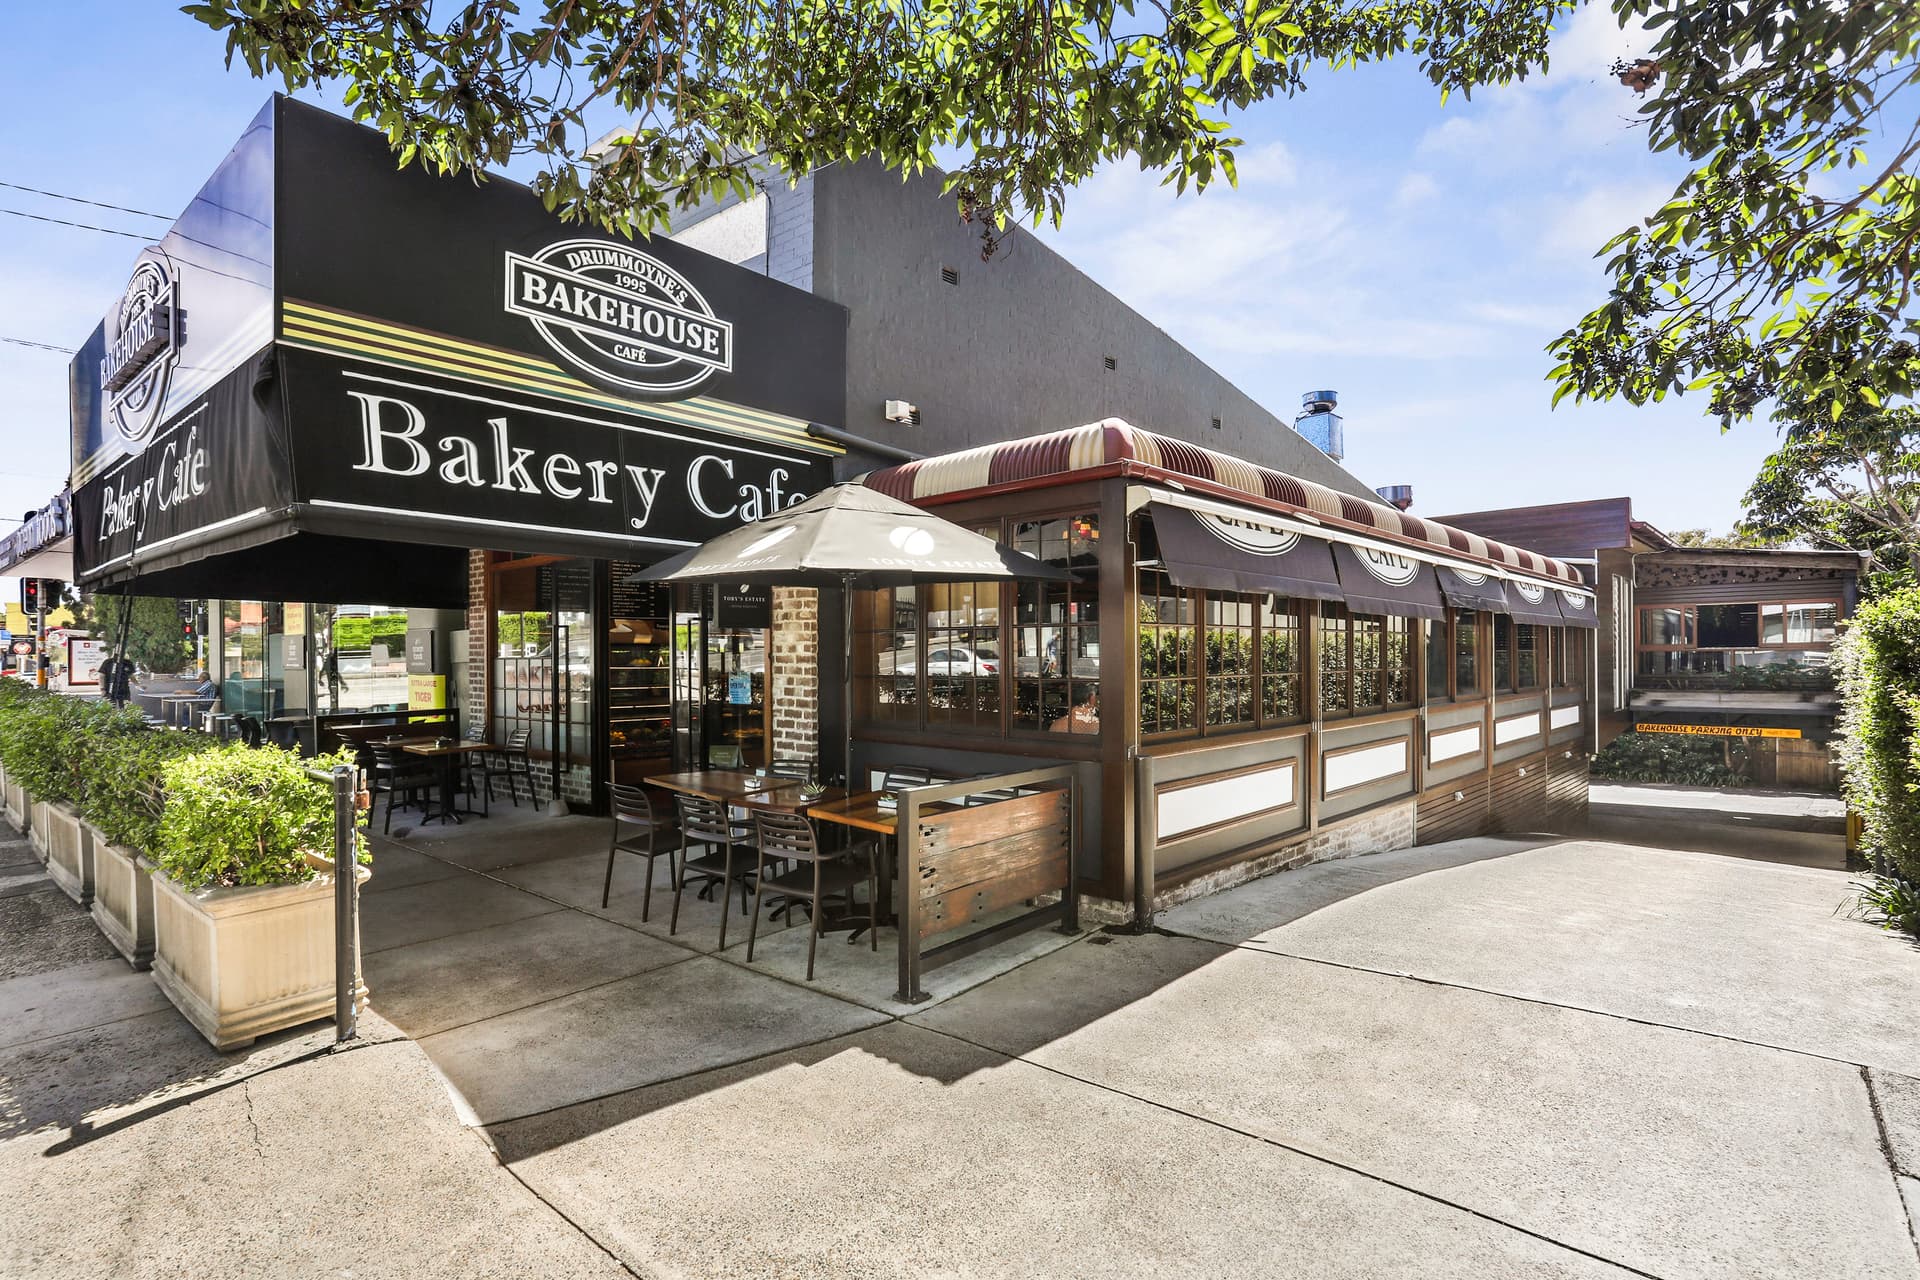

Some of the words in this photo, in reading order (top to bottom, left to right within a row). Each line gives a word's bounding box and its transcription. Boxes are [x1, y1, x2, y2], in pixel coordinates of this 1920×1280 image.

[566, 249, 688, 303] DRUMMOYNE'S
[614, 273, 647, 293] 1995
[522, 271, 719, 355] BAKEHOUSE
[100, 307, 155, 389] BAKEHOUSE
[614, 343, 647, 364] CAFÉ
[347, 390, 666, 529] Bakery
[415, 691, 432, 703] TIGER
[1638, 724, 1688, 733] BAKEHOUSE
[1690, 725, 1732, 735] PARKING
[1735, 728, 1763, 737] ONLY
